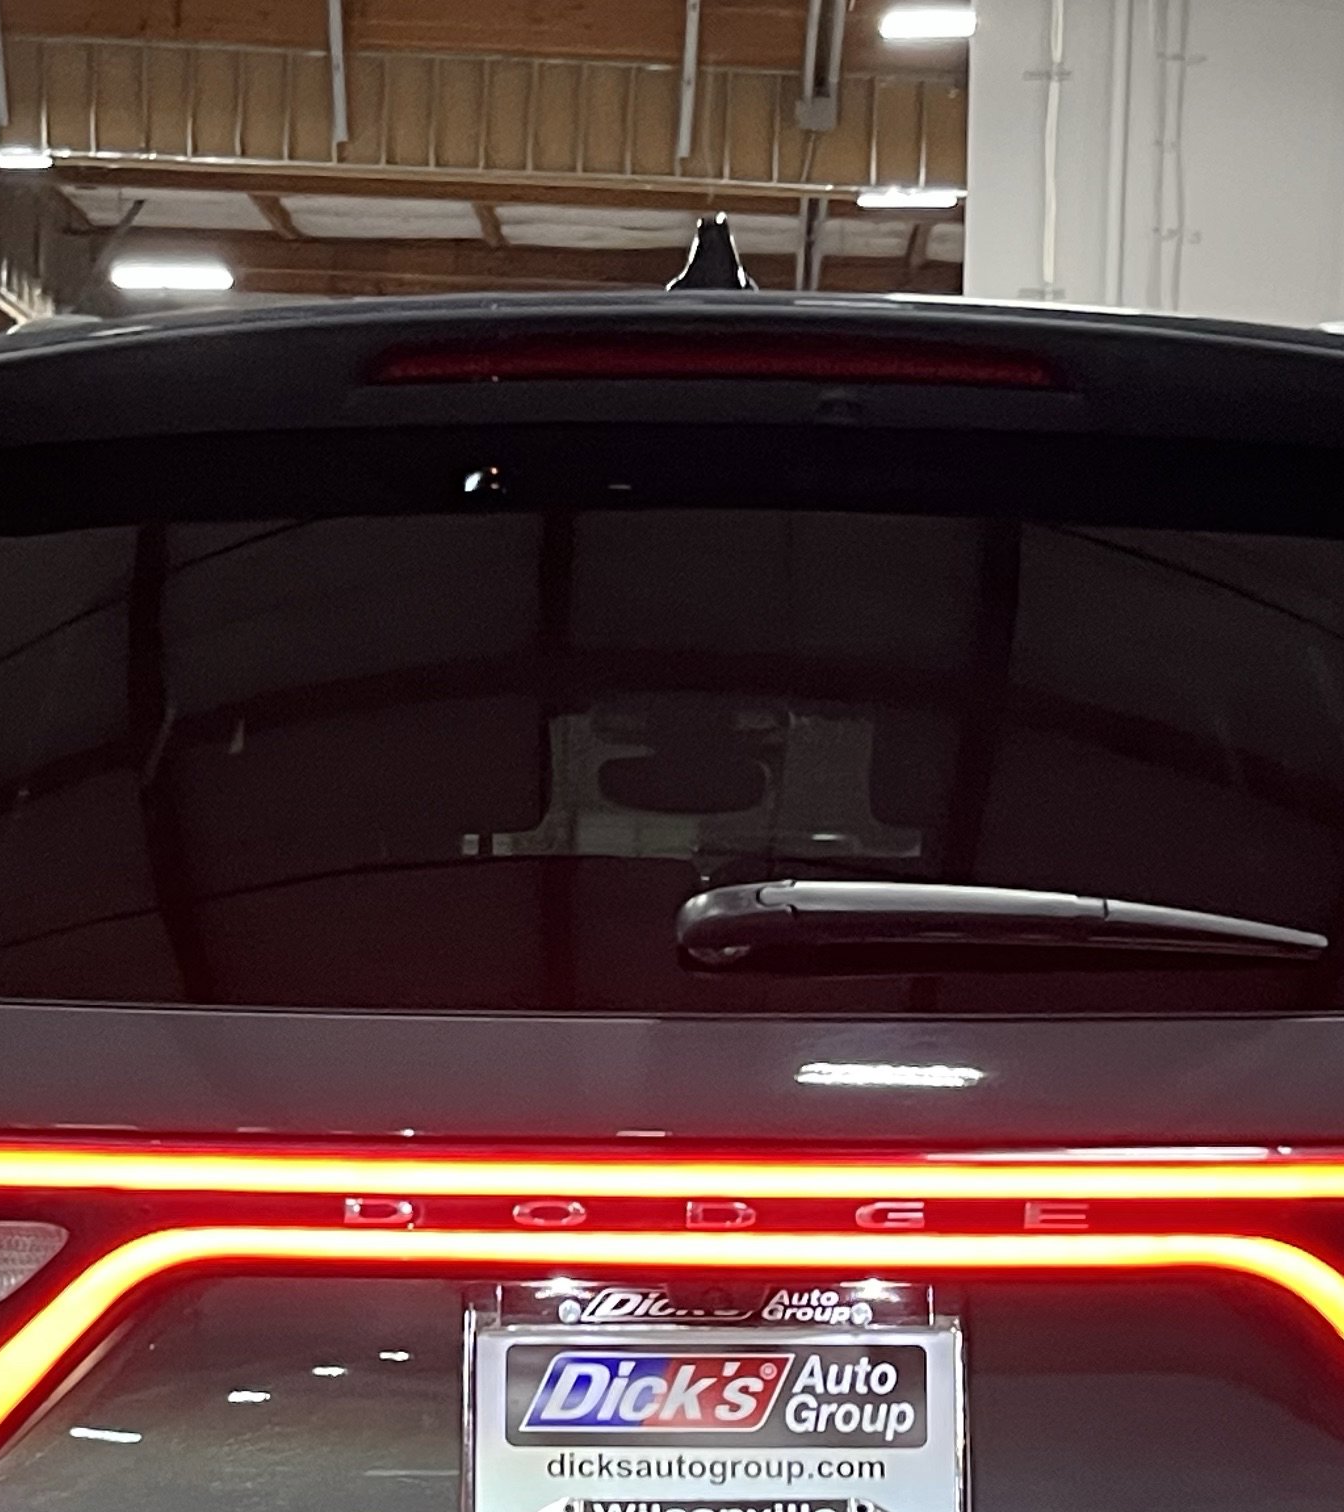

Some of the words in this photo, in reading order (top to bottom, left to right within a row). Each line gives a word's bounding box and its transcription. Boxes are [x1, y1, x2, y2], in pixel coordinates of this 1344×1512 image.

[343, 1197, 1090, 1231] DODGE
[768, 1288, 840, 1306] Auto
[761, 1303, 852, 1326] Group
[540, 1360, 765, 1423] Dick's
[792, 1354, 898, 1396] Auto
[784, 1396, 916, 1442] Group
[546, 1453, 887, 1485] dicksautogroup.com
